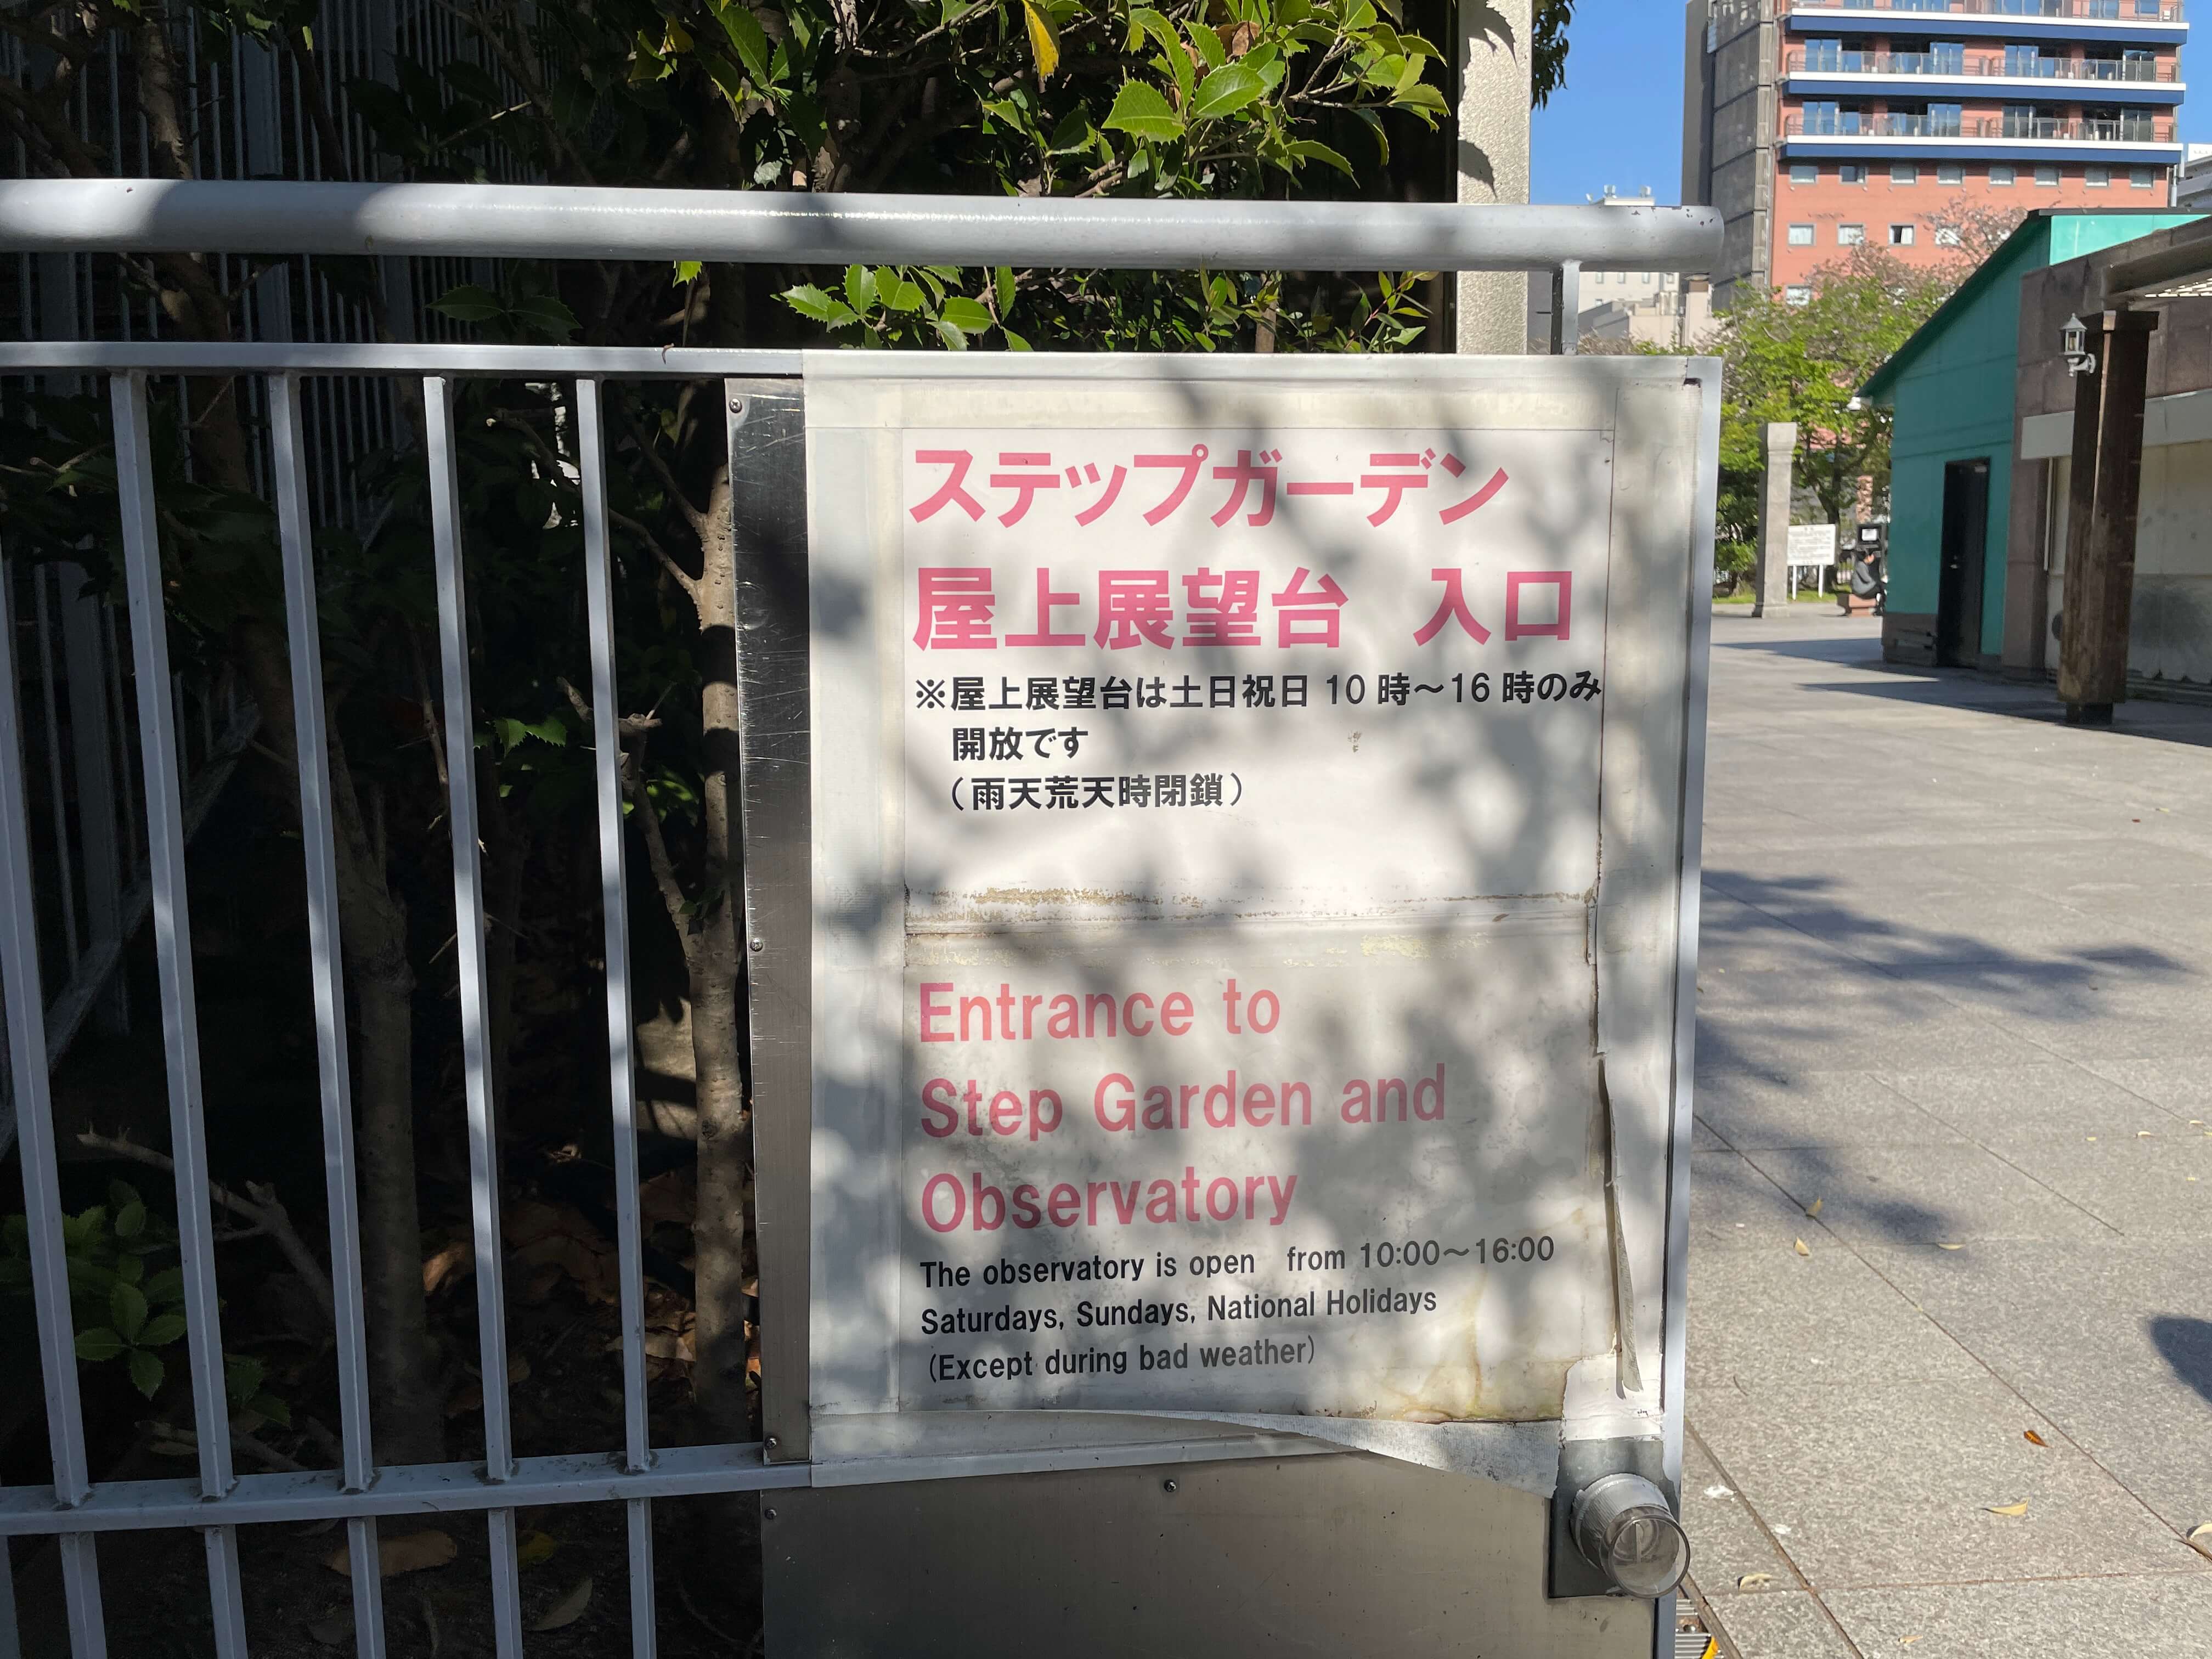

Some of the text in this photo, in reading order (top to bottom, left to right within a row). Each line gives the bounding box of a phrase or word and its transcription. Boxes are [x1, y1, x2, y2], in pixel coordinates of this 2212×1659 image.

[909, 443, 1509, 528] ステップガーデン
[912, 567, 1572, 651] 屋上展望台 入口
[952, 726, 1088, 761] 開放です
[919, 978, 1280, 1042] Entrance to
[921, 1063, 1446, 1142] Step Garden and
[922, 1166, 1297, 1233] Observatory
[920, 1261, 970, 1288] The
[984, 1255, 1144, 1285] observatory
[1157, 1251, 1177, 1277] is
[1190, 1254, 1255, 1278] open
[1286, 1246, 1345, 1271] from
[921, 1288, 1437, 1336] Saturdays, Sundays, National Holidays
[929, 1335, 1314, 1383] (Except during bad weather)
